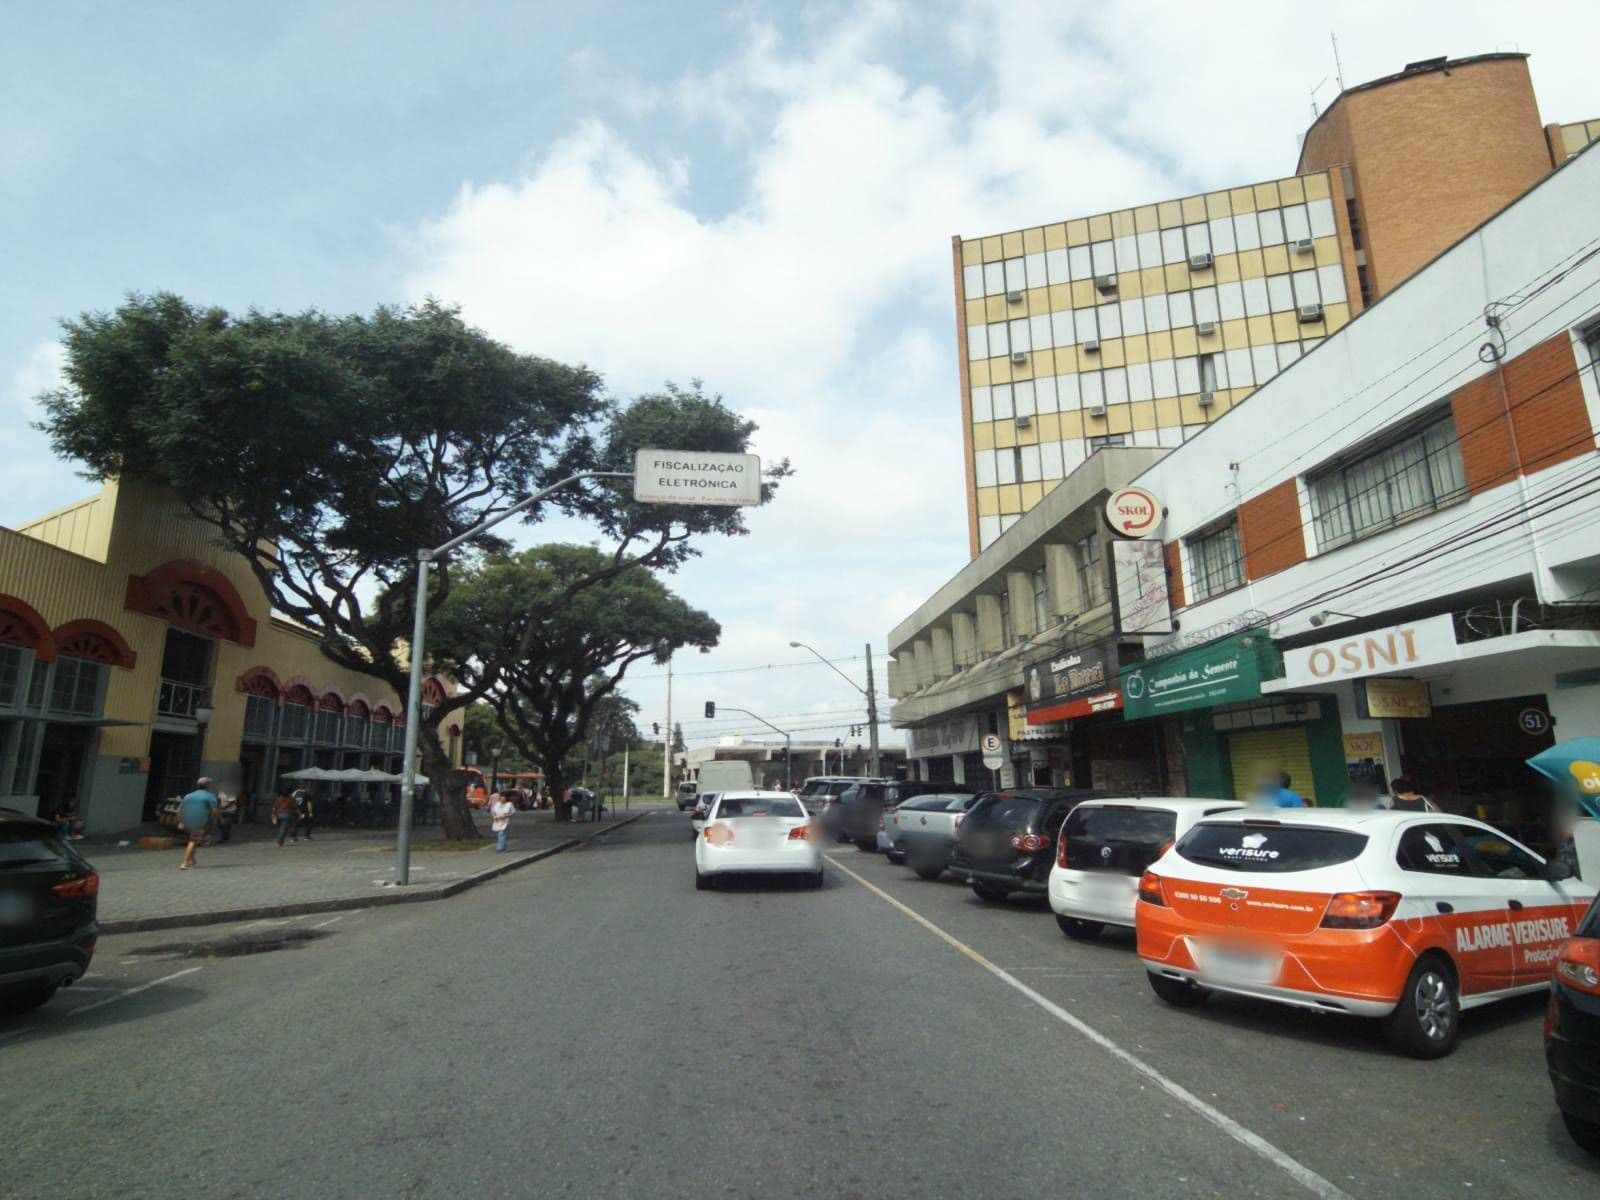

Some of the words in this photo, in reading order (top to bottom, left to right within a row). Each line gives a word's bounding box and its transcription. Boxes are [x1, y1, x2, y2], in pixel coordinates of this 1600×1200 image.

[654, 460, 744, 473] FISCALIZAÇÃO
[659, 477, 738, 489] ELETRÔNICA
[1118, 506, 1151, 515] SKOL
[1308, 629, 1418, 678] OSNI
[1525, 714, 1543, 729] 51
[987, 738, 996, 748] E
[1219, 847, 1279, 859] verisure
[1425, 854, 1461, 863] verisure
[1456, 924, 1511, 952] ALARME
[1512, 917, 1570, 945] VERISURE
